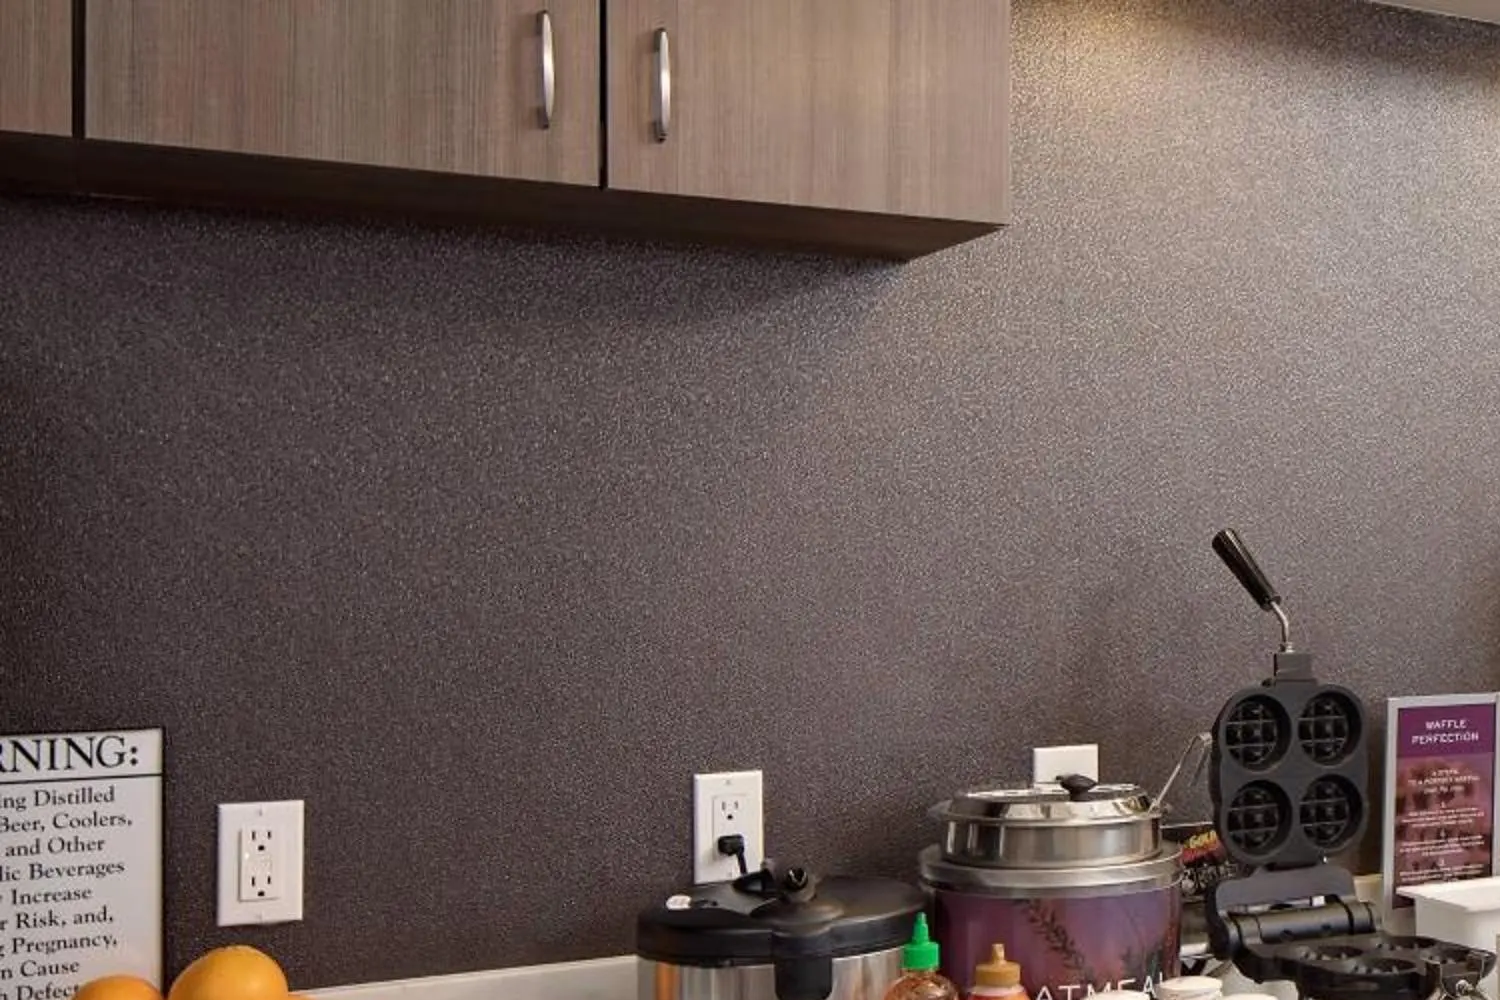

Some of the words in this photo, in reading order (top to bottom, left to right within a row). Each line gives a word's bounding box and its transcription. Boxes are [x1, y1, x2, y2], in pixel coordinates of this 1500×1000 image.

[1425, 719, 1467, 730] WAFFLE
[1411, 731, 1479, 745] PERFECTION
[0, 736, 139, 773] NING:
[34, 785, 115, 807] Distilled
[52, 809, 132, 830] Coolers,
[5, 838, 40, 857] and
[47, 836, 105, 855] Other
[29, 859, 125, 881] Beverages
[12, 887, 92, 905] Increase
[16, 909, 66, 929] Risk,
[73, 905, 113, 926] and,
[12, 934, 117, 955] Pregnancy,
[20, 960, 80, 977] Cause
